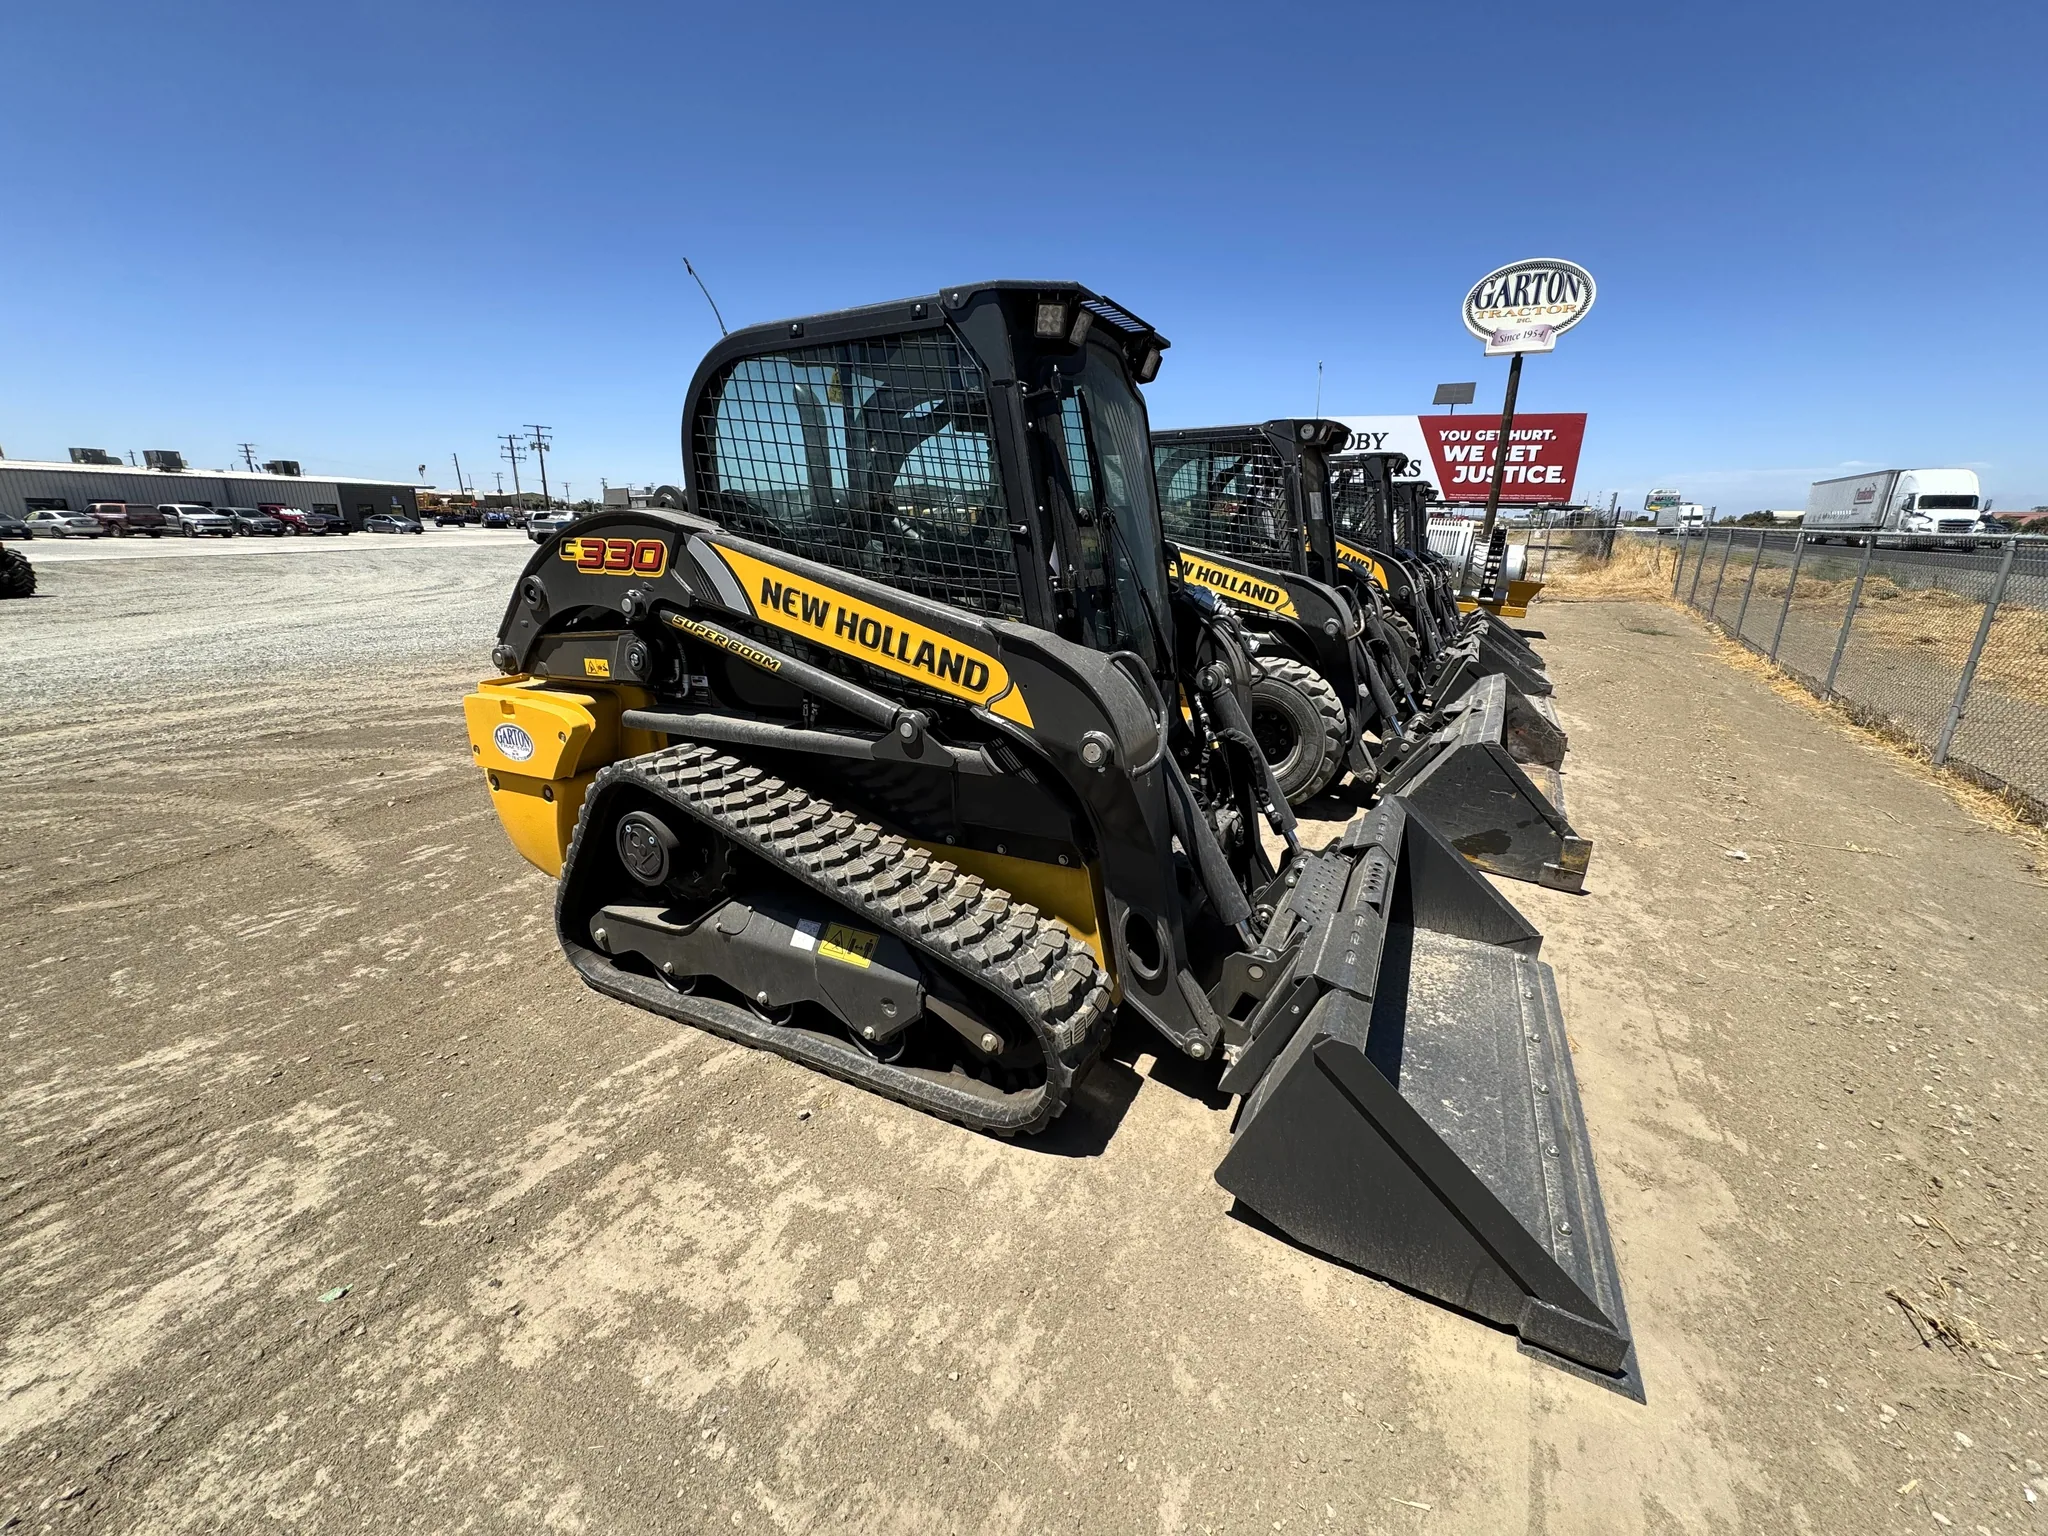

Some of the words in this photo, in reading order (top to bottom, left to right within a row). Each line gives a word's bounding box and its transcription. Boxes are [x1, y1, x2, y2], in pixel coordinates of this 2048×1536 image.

[1474, 271, 1581, 310] GARTON
[1475, 304, 1577, 319] TRACTOR
[1498, 332, 1521, 343] Since
[1523, 329, 1545, 339] 1954
[1439, 430, 1471, 441] YOU
[1509, 429, 1557, 441] HURT.
[1443, 445, 1485, 462] WE
[1195, 565, 1280, 605] HOLLAND
[672, 614, 728, 647] SUPER
[728, 640, 781, 672] BOOM
[760, 576, 831, 629] NEW
[834, 606, 990, 694] HOLLAND
[496, 728, 531, 748] GARTON
